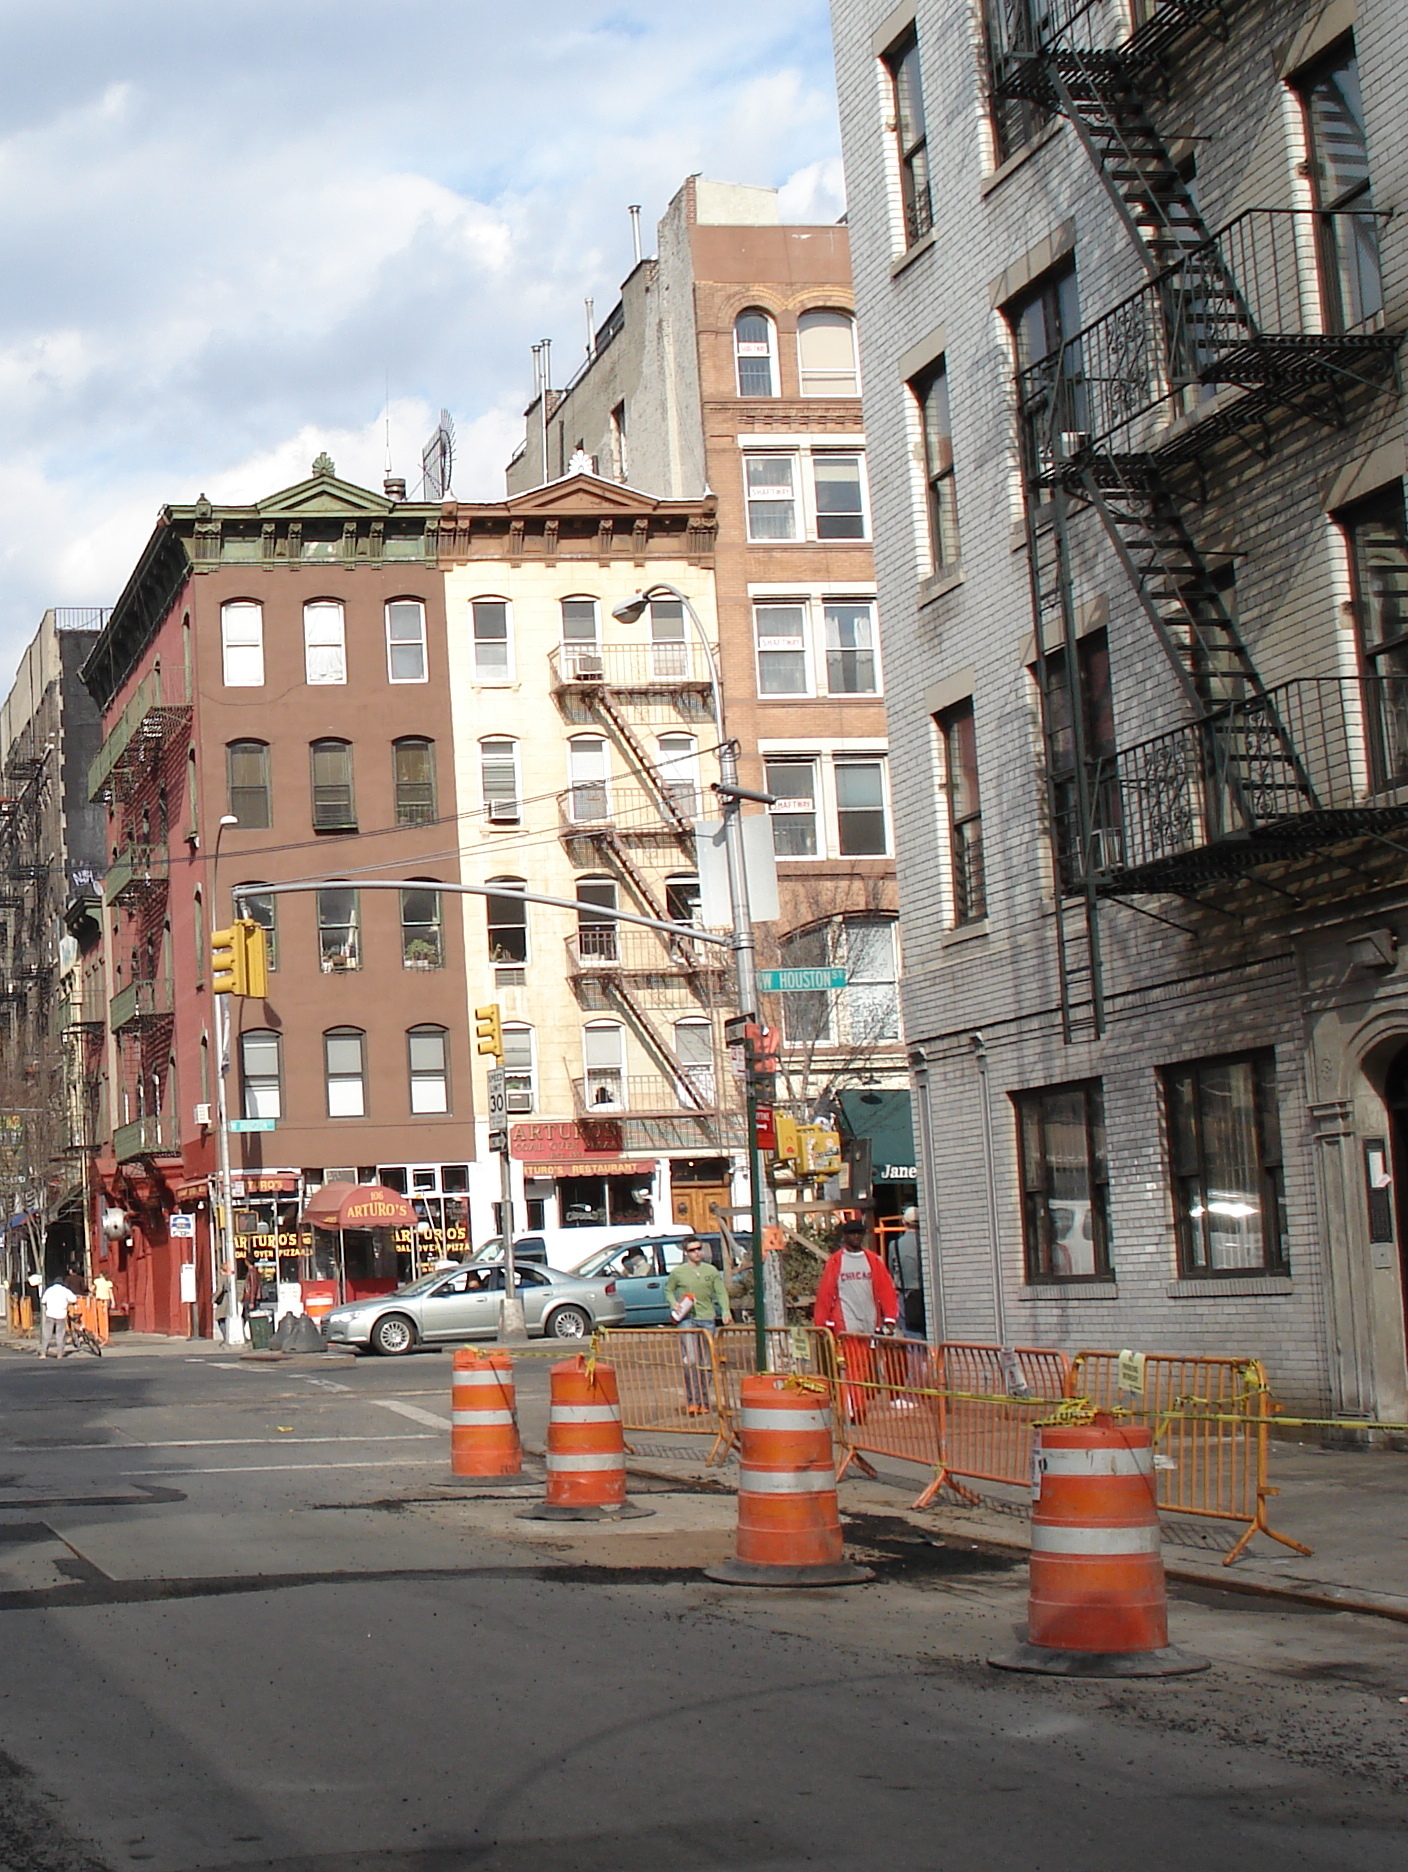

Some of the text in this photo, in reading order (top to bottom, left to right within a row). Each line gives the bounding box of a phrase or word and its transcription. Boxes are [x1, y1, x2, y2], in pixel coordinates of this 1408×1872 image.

[763, 969, 843, 989] W HOUSTON ST
[490, 1094, 503, 1113] 30
[572, 1163, 638, 1174] RESTAURANT
[881, 1164, 918, 1179] Jane
[370, 1191, 384, 1201] 106
[347, 1202, 408, 1218] ARTURO'S
[278, 1248, 300, 1257] PIZZA
[396, 1244, 411, 1253] OAL
[446, 1243, 470, 1252] PIZZA
